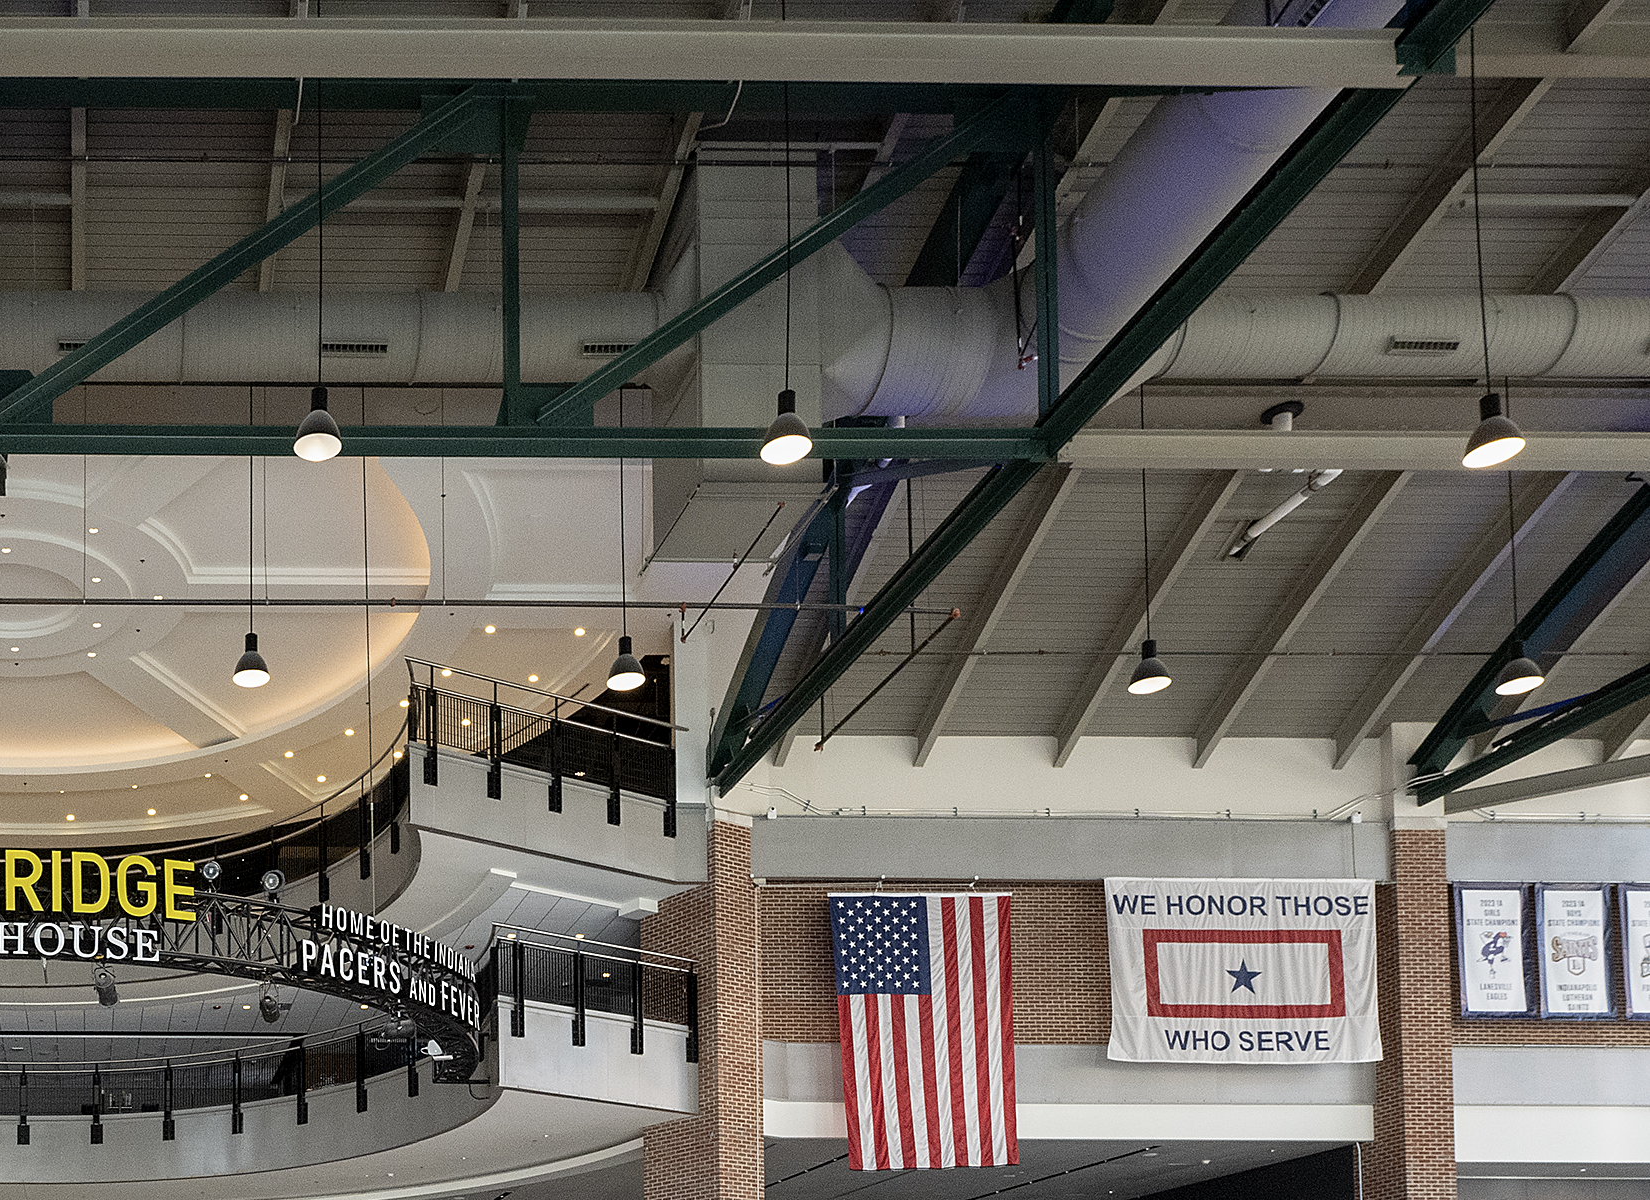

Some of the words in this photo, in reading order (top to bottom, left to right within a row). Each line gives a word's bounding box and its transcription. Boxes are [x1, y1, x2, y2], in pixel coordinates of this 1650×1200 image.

[1112, 894, 1156, 915] WE
[1166, 895, 1268, 916] HONOR
[1276, 896, 1369, 916] THOSE
[321, 903, 375, 940] HOME
[404, 928, 431, 959] THE
[434, 940, 476, 983] INDIANA
[302, 939, 400, 994] PACERS
[409, 977, 436, 1006] AND
[441, 981, 480, 1031] FEVER
[1165, 1029, 1231, 1051] WHO
[1239, 1030, 1330, 1051] SERVE
